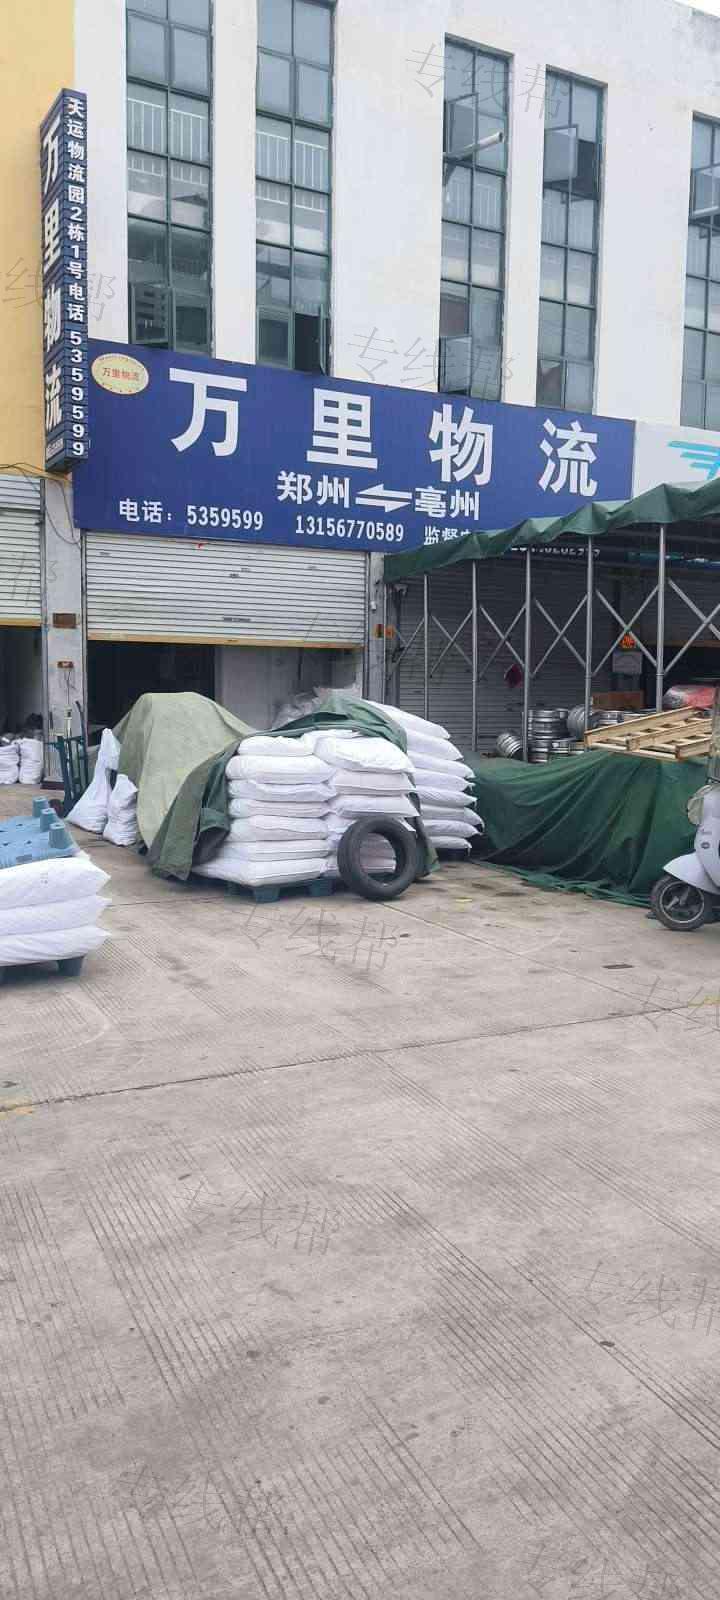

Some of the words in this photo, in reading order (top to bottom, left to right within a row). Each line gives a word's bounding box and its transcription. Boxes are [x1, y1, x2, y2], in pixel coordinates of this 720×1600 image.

[43, 117, 62, 432] 万里物流
[169, 367, 599, 498] 万里物流
[277, 471, 350, 509] 郑州
[295, 515, 405, 542] 13156770589
[424, 525, 472, 545] 监督
